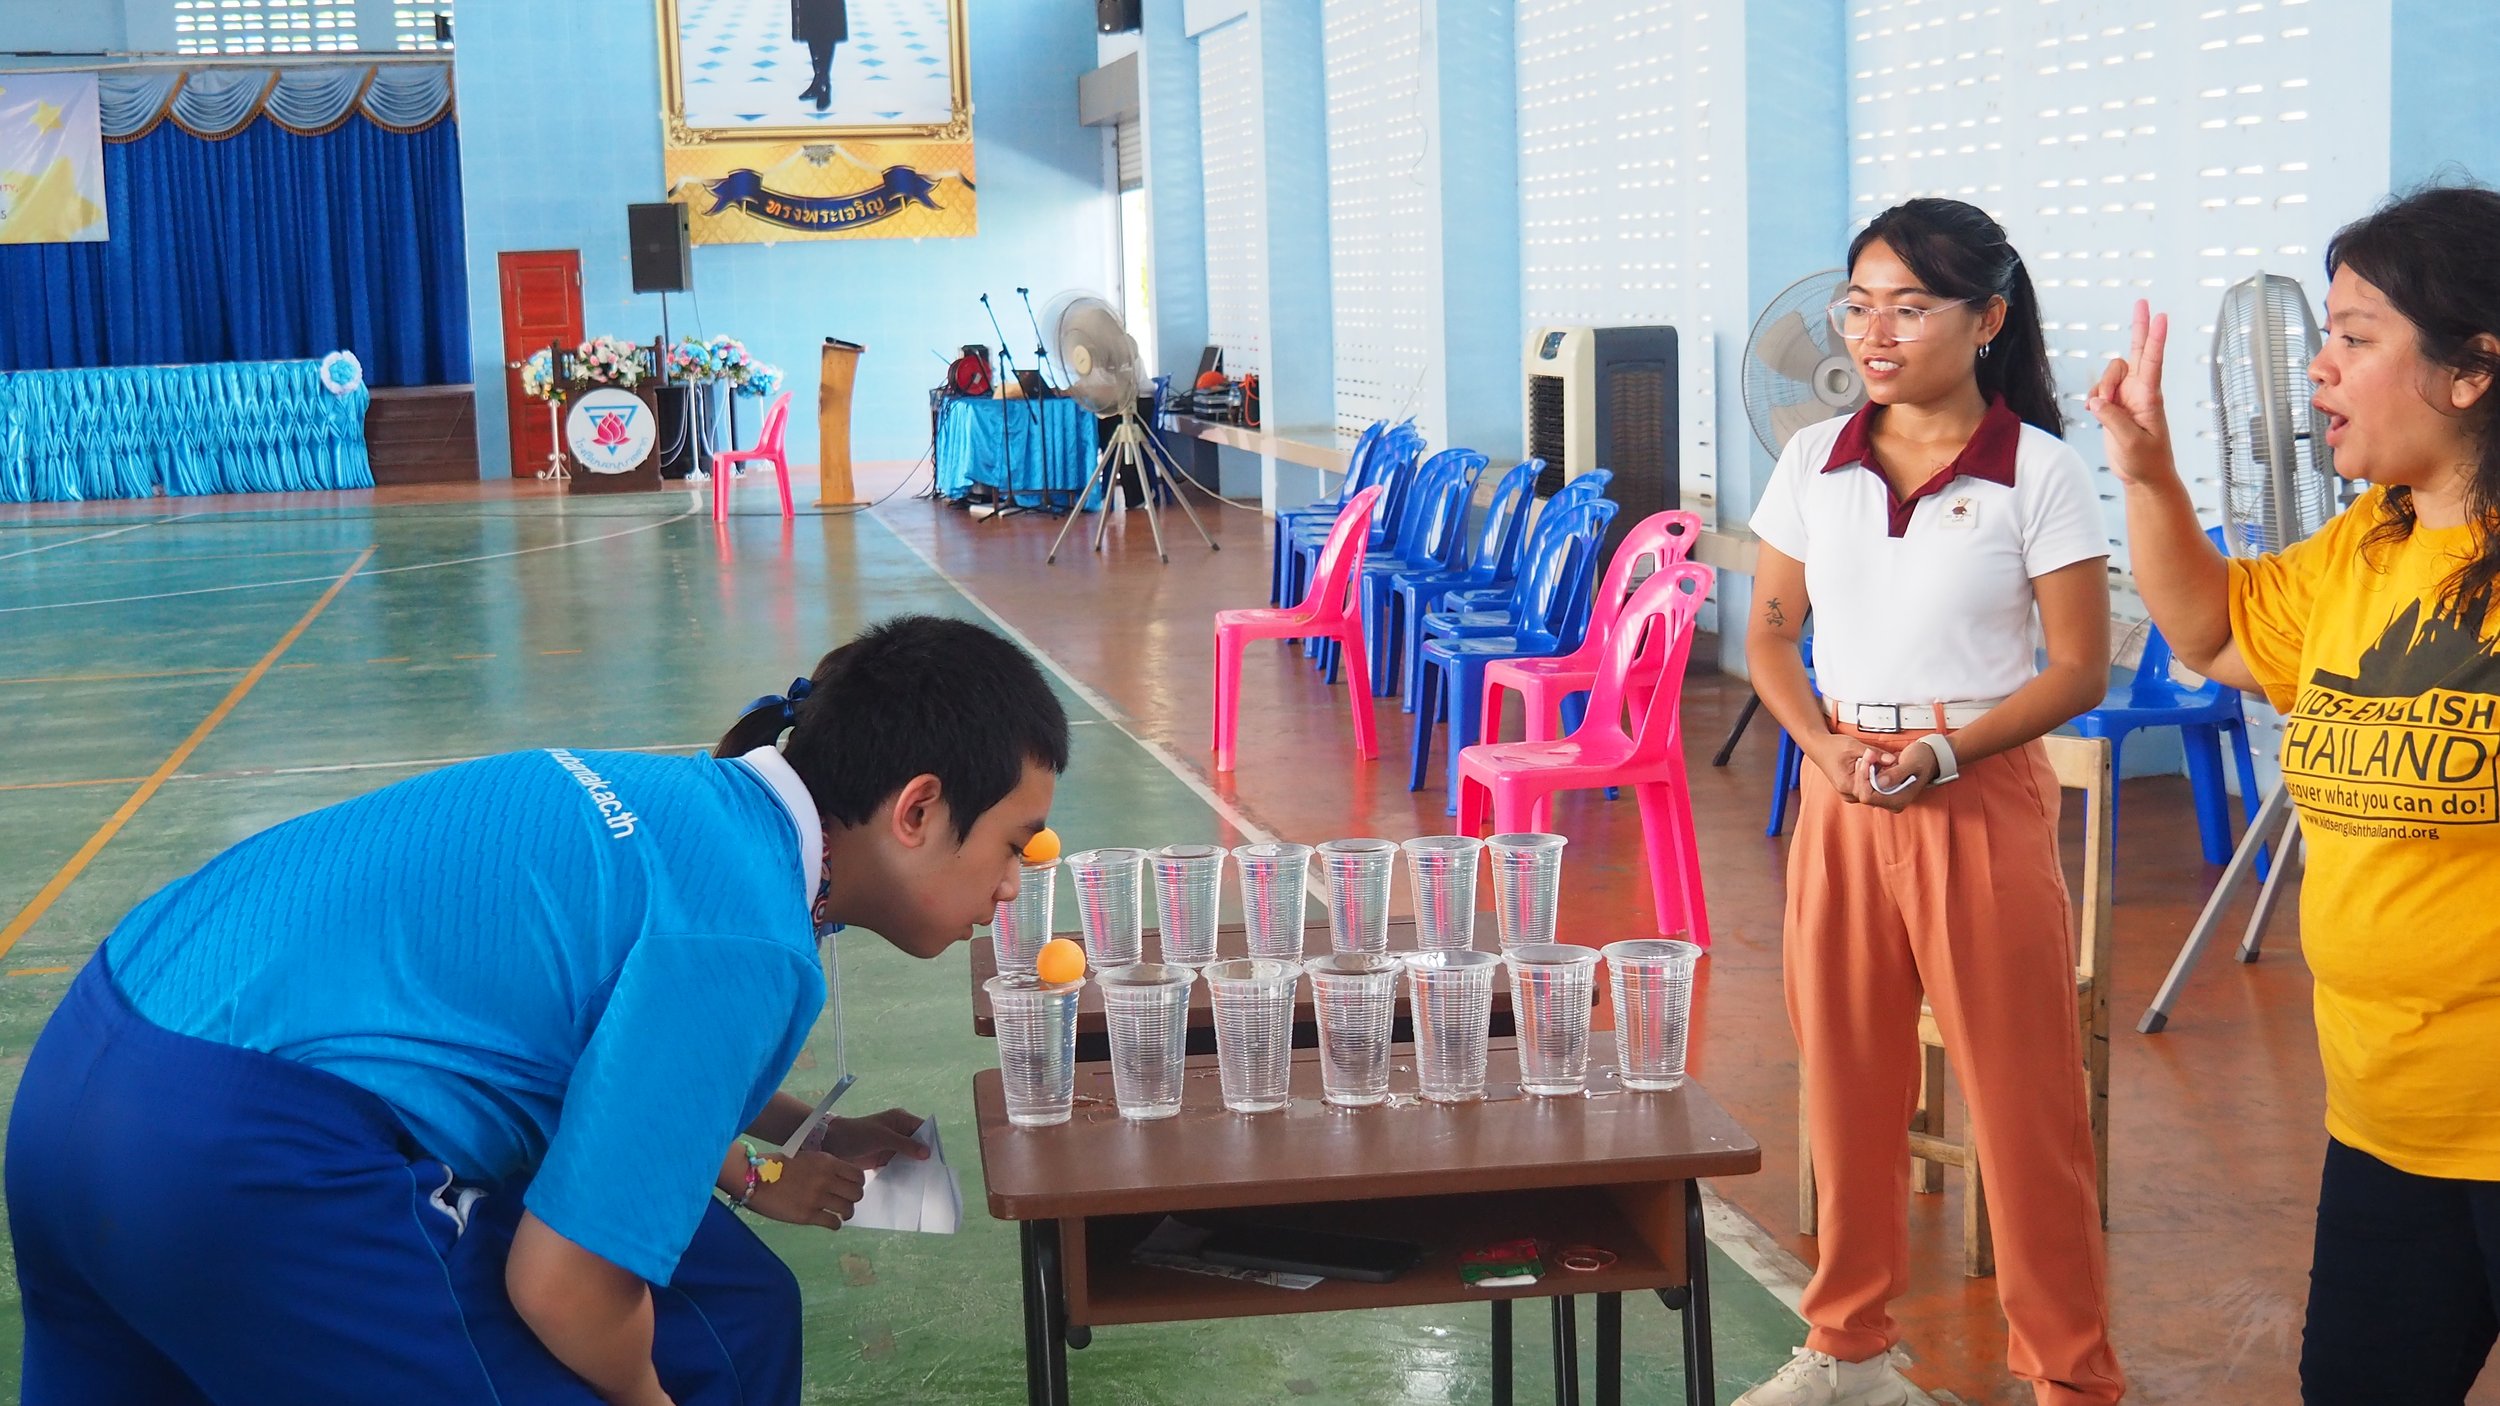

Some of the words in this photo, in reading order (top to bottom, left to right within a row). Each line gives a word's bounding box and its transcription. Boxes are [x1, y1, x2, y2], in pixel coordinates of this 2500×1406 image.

[765, 197, 887, 224] ทรงพระเจริญ
[2285, 721, 2488, 782] HAILAND
[2324, 784, 2359, 809] what
[2362, 792, 2389, 814] you
[2393, 794, 2433, 814] can
[2441, 793, 2486, 815] do!
